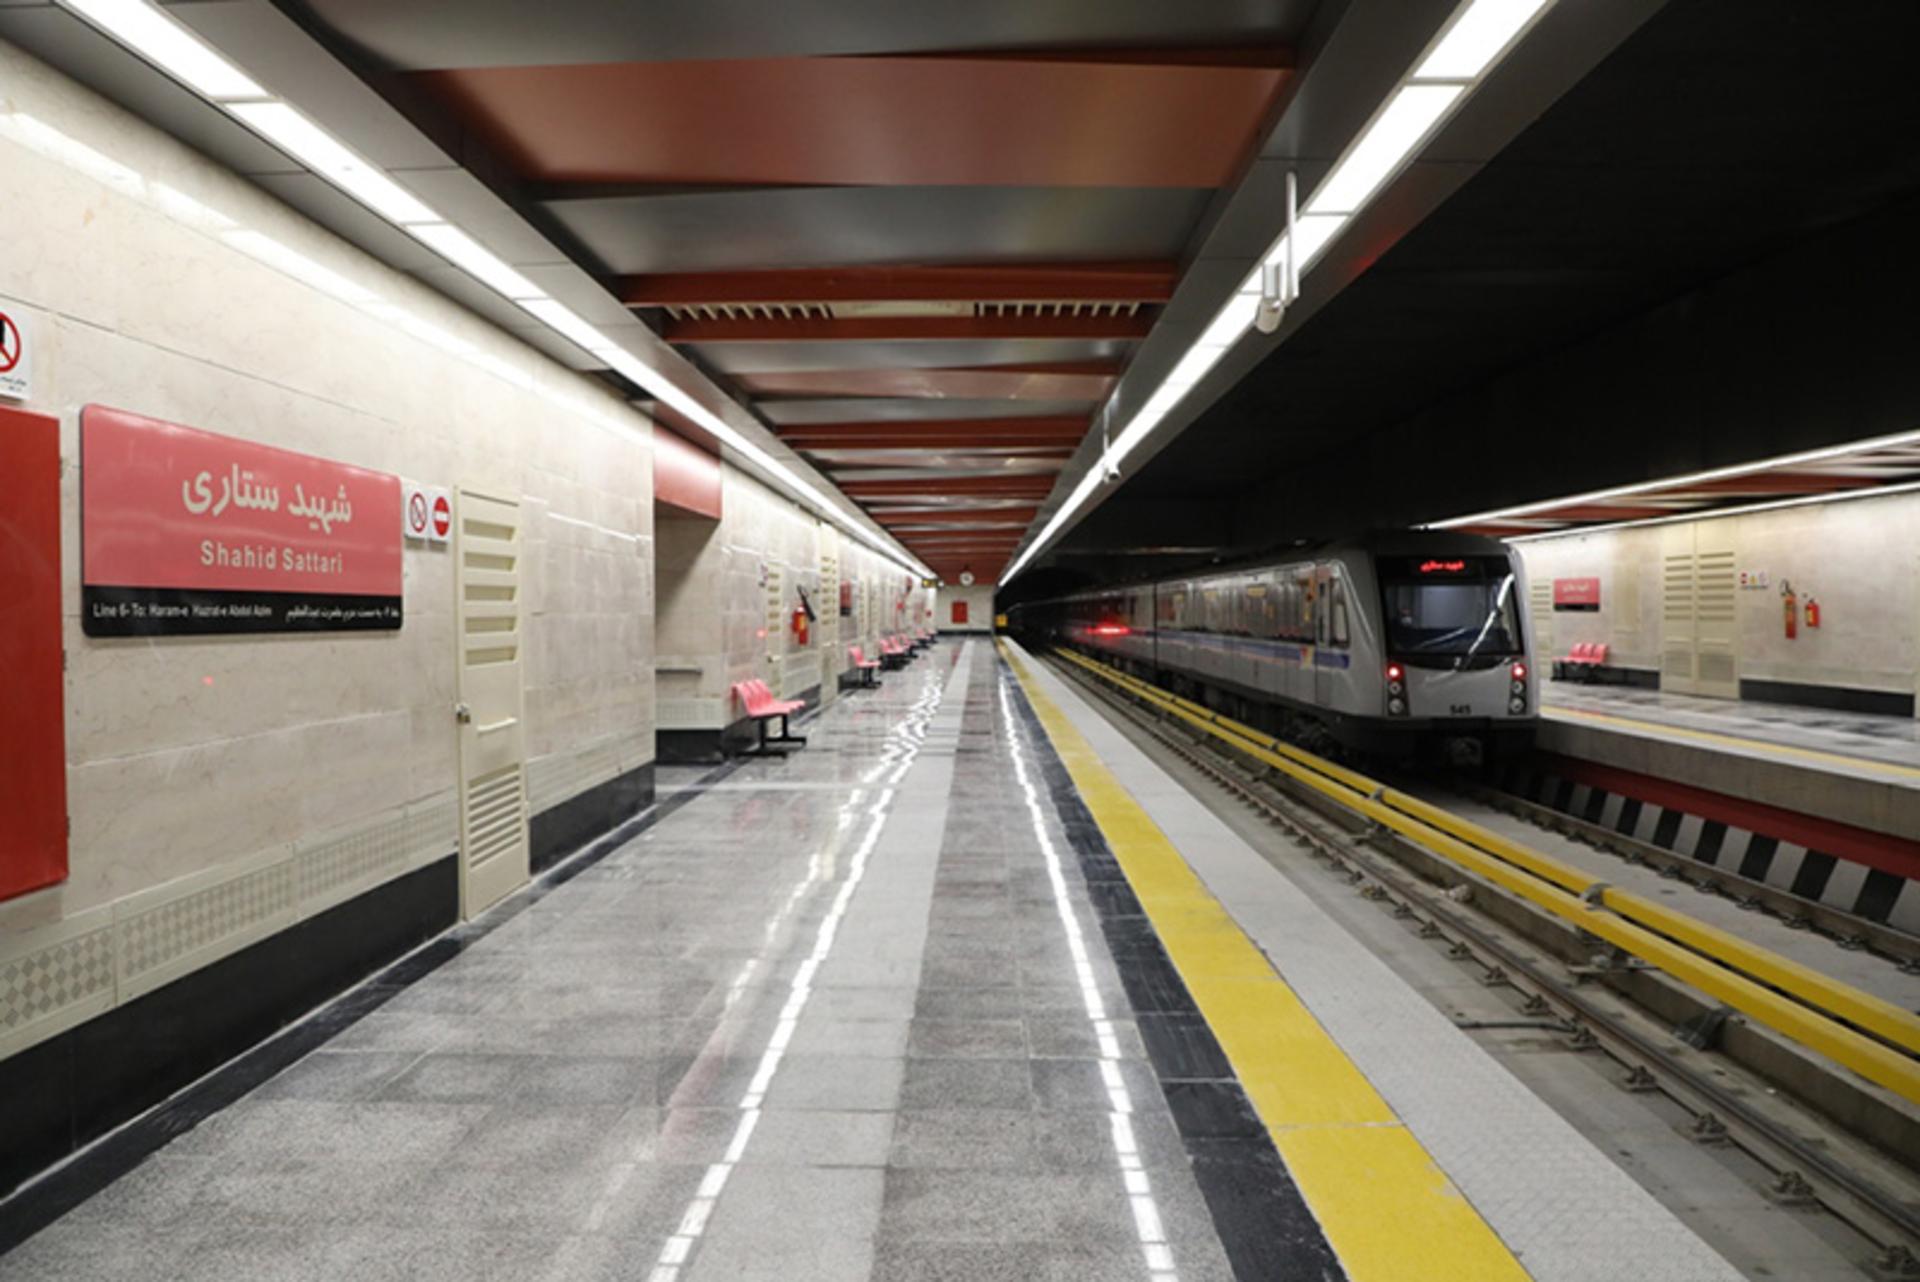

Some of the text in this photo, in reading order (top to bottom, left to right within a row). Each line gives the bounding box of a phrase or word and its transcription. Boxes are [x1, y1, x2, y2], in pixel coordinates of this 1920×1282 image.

[182, 462, 352, 533] شهید ستاری
[201, 540, 343, 575] Shahid Sattari
[93, 602, 116, 618] Line
